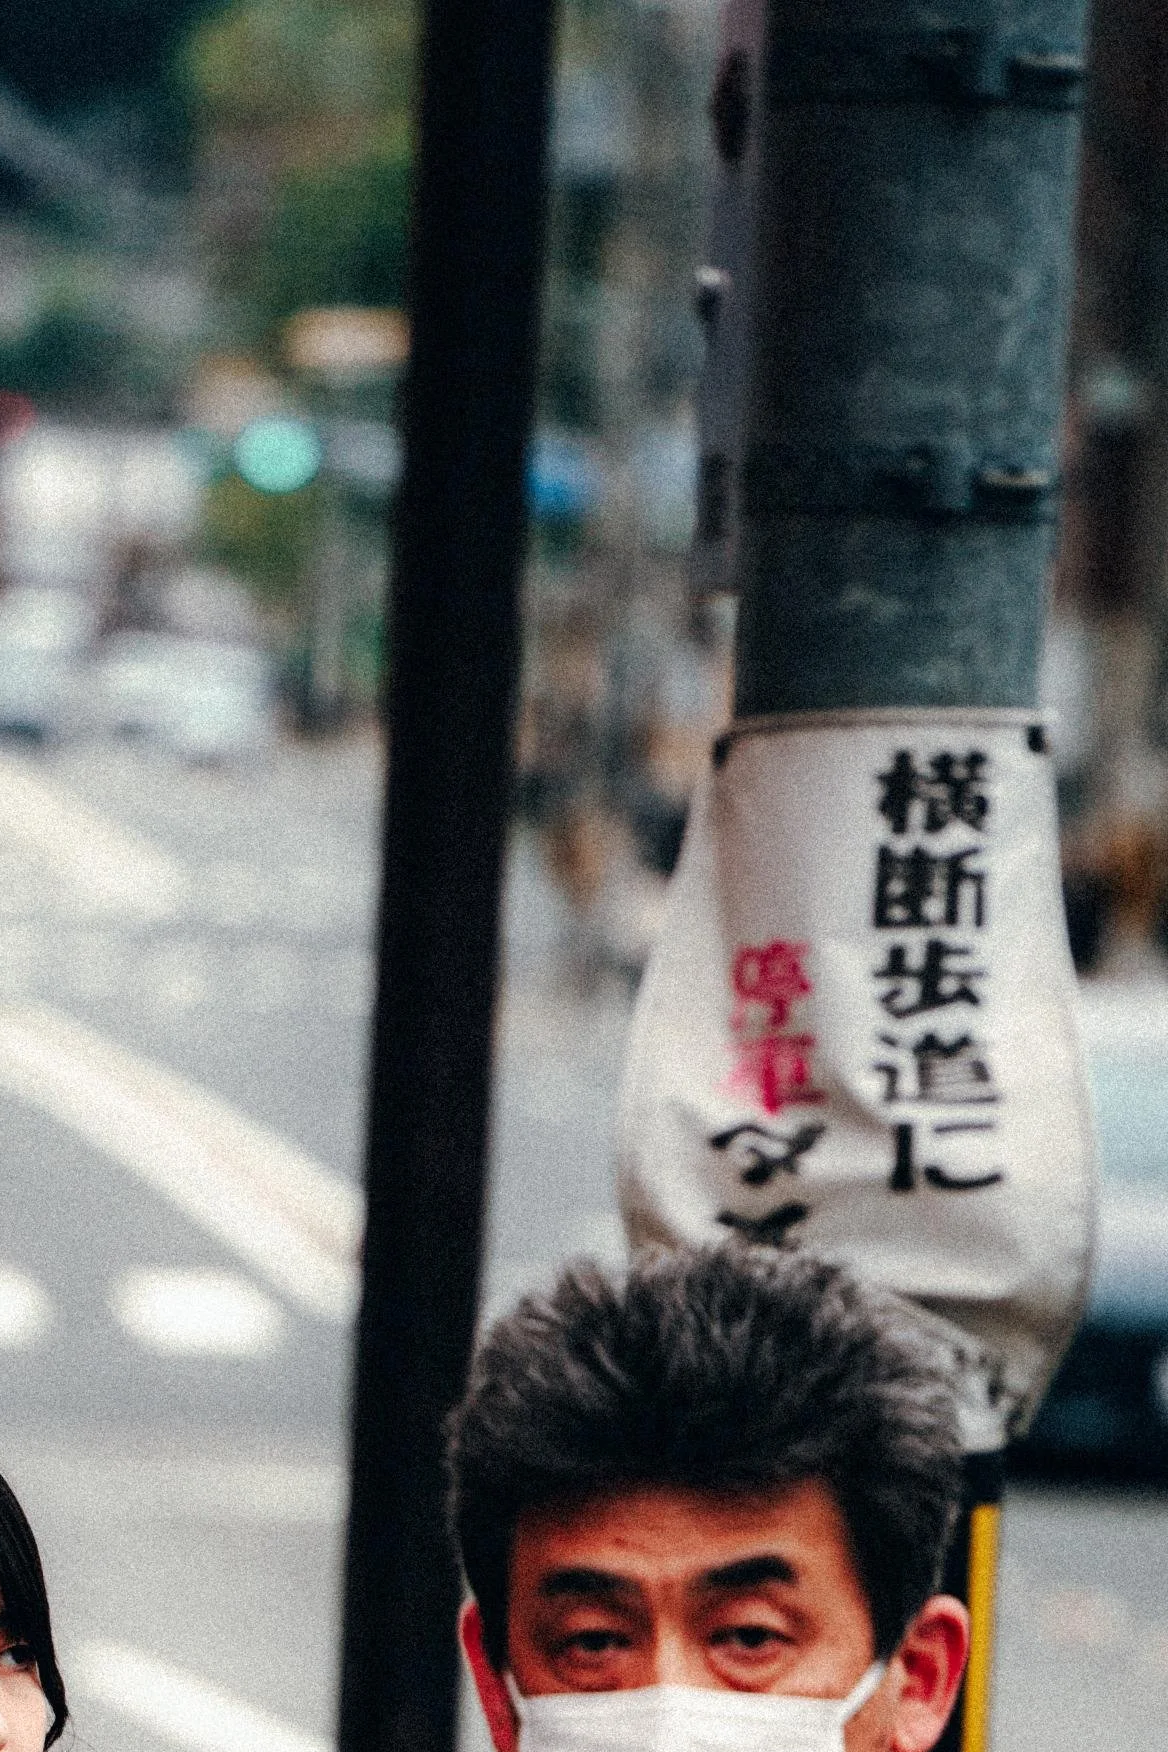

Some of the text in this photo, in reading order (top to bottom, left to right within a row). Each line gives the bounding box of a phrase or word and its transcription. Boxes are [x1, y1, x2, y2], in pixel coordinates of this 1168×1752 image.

[872, 750, 1003, 1192] 横断歩道に
